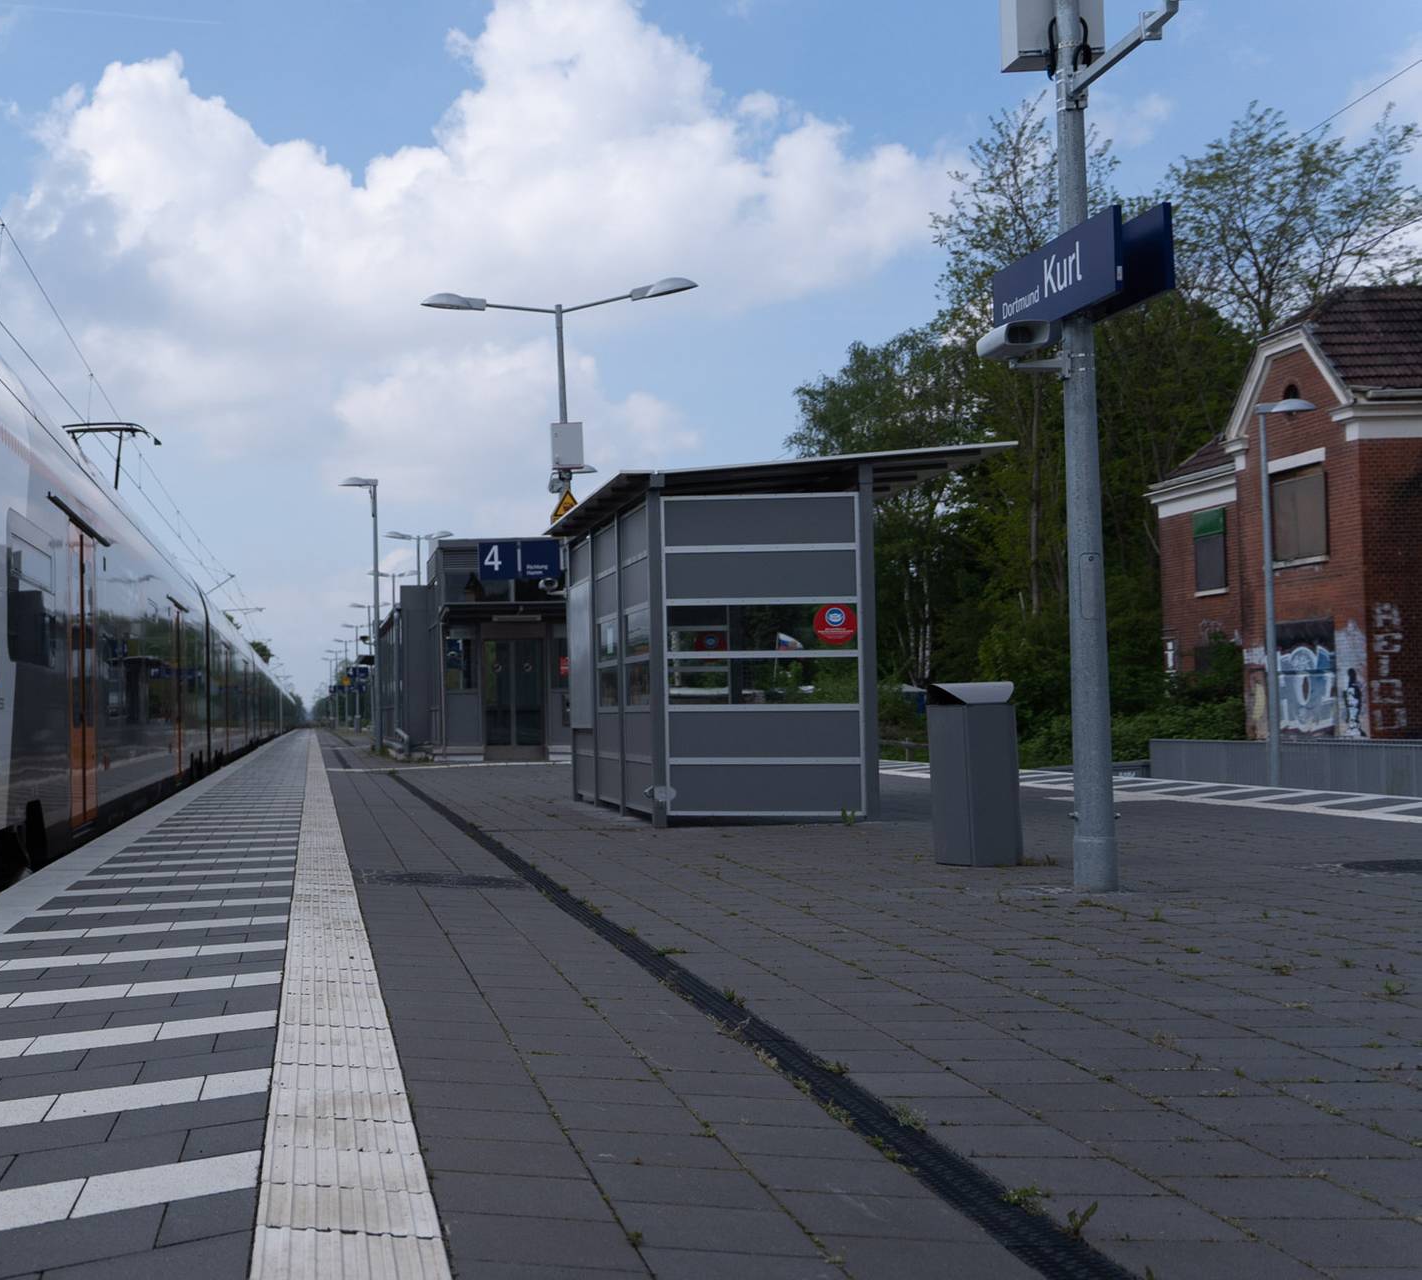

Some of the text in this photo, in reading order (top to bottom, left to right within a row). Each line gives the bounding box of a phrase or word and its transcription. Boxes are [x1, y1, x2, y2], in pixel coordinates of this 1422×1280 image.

[1002, 240, 1083, 320] Dortmund Kurl
[484, 545, 502, 571] 4
